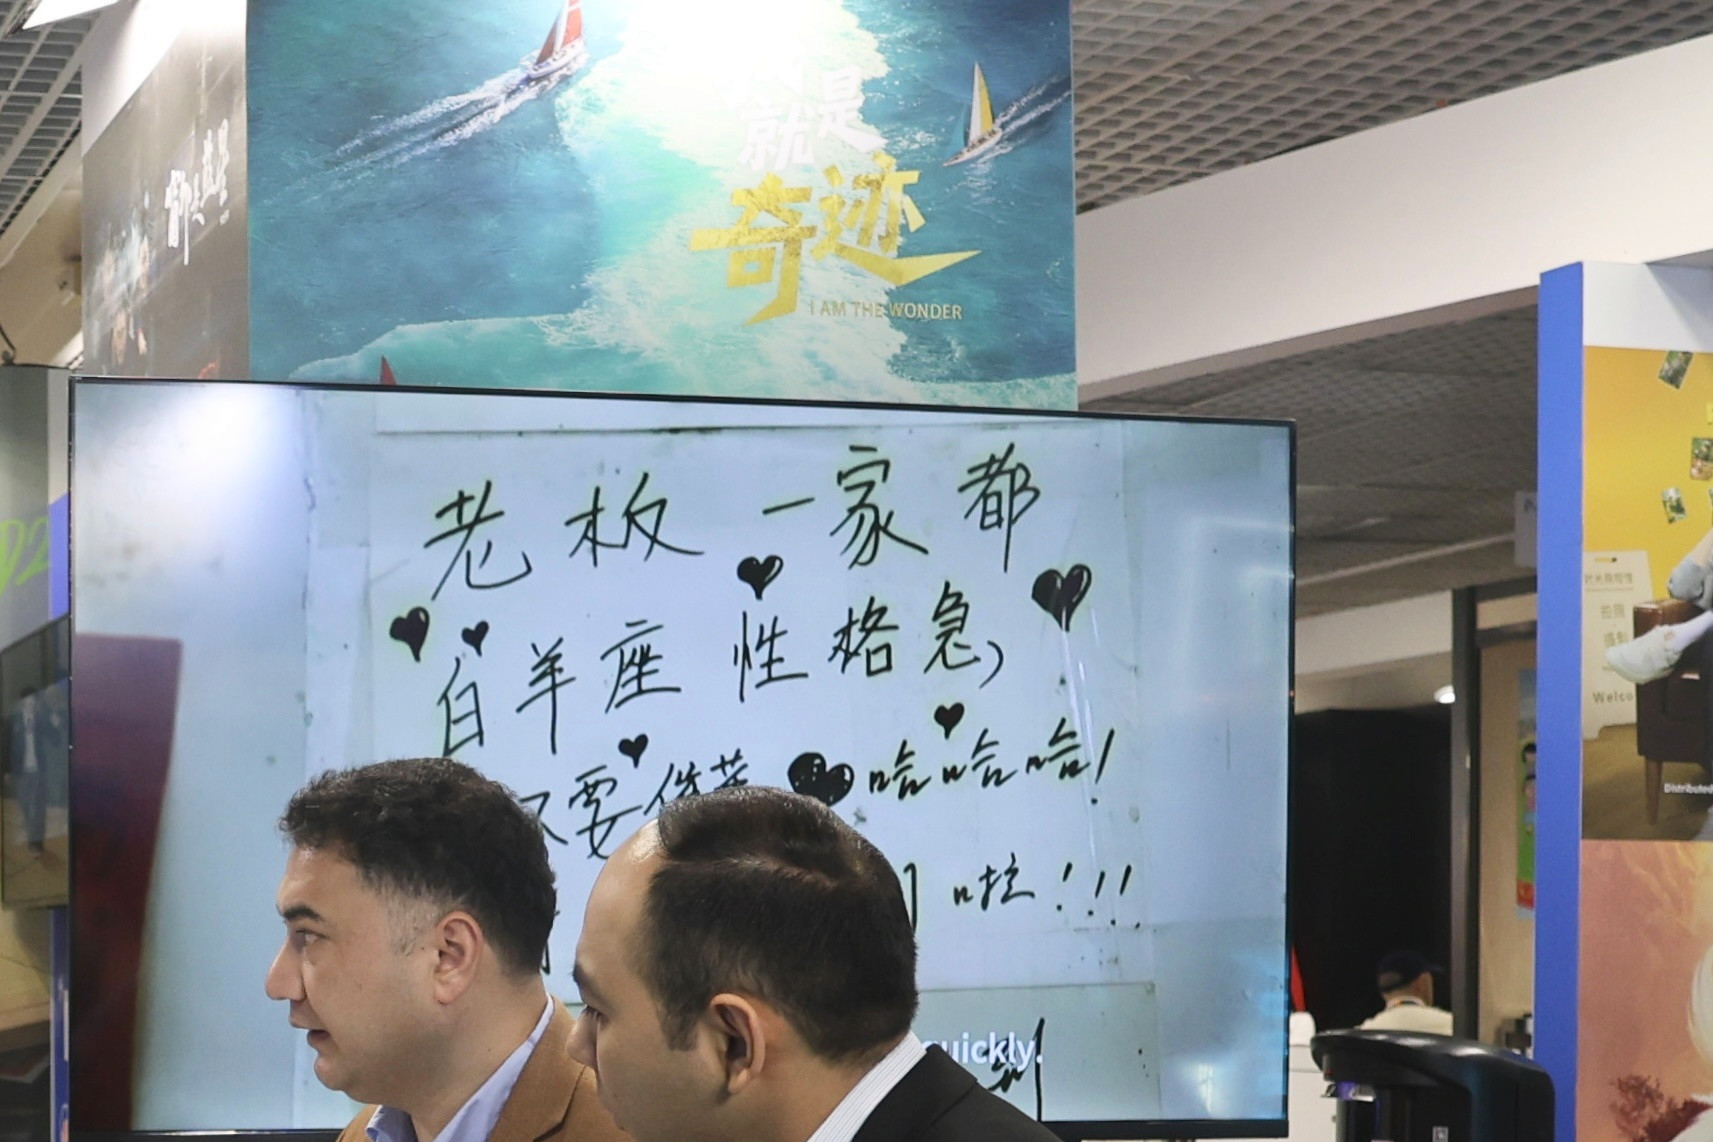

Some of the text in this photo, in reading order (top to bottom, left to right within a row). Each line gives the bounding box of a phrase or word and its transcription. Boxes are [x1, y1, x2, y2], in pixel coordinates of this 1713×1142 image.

[688, 151, 982, 328] 奇迹
[820, 302, 847, 317] AM
[853, 302, 884, 318] THE
[889, 303, 963, 320] WONDER
[425, 443, 1040, 601] 老板一家都
[922, 1031, 1044, 1073] uickly.
